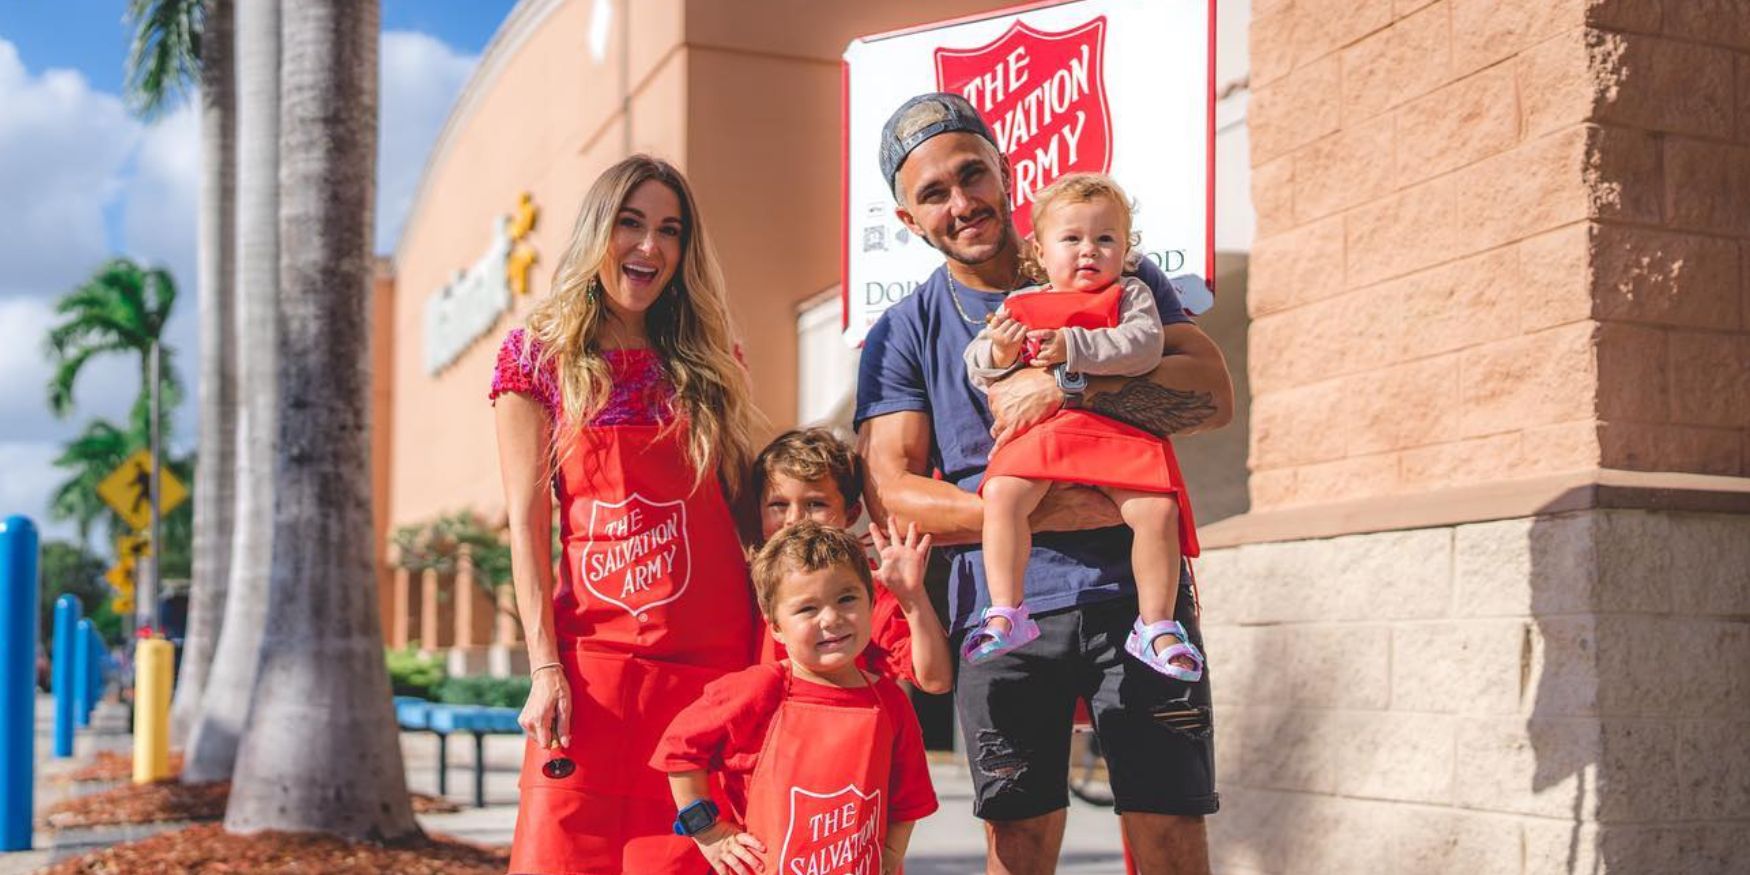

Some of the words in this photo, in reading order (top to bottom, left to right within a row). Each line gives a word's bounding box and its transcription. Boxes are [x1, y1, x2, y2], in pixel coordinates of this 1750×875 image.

[963, 46, 1031, 112] THE
[992, 44, 1089, 154] VATION
[1010, 111, 1086, 212] RMY
[590, 512, 678, 582] SALVATION
[605, 508, 643, 538] THE
[620, 545, 677, 599] ARMY
[809, 802, 857, 842] THE
